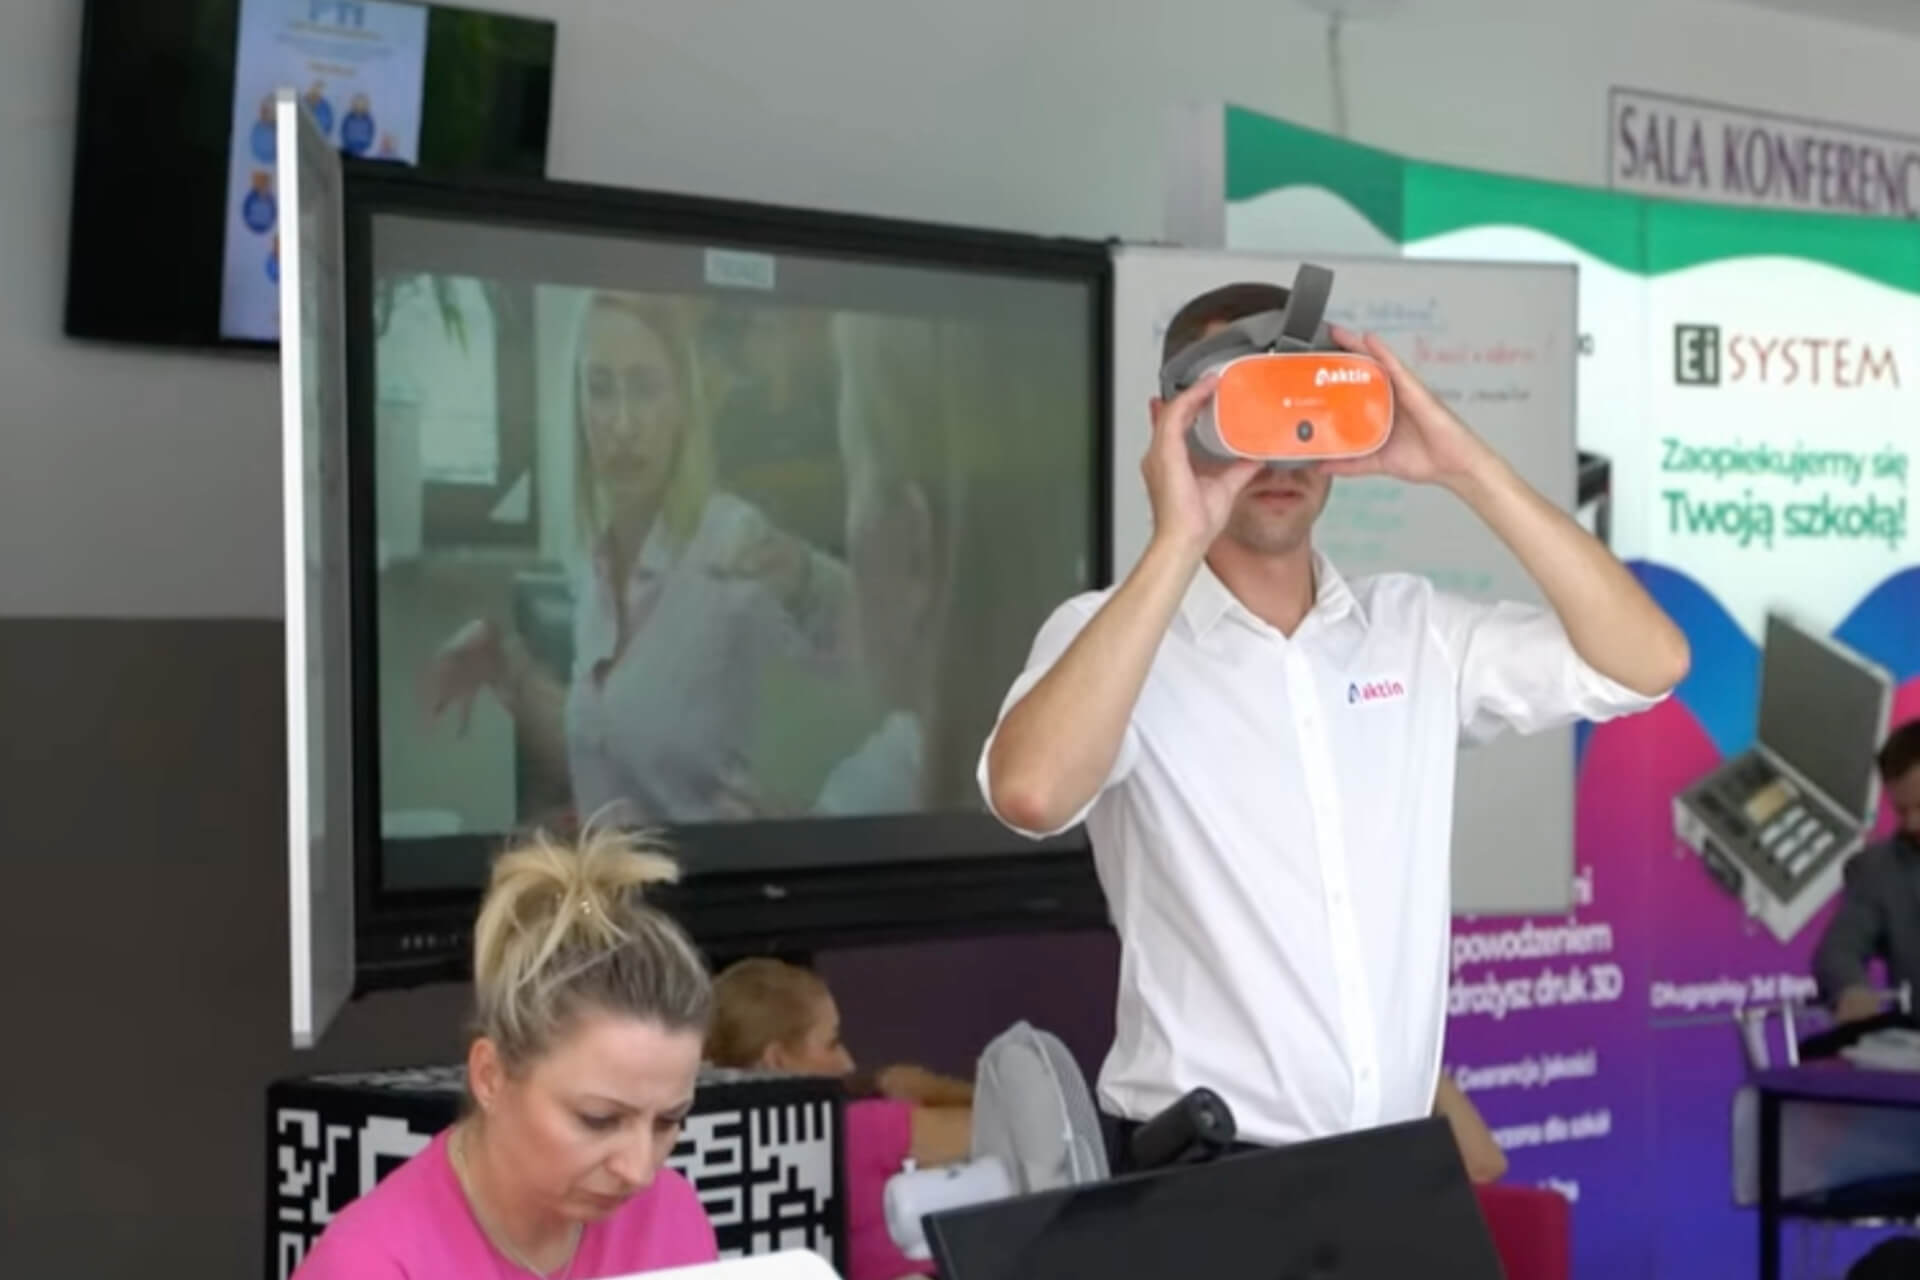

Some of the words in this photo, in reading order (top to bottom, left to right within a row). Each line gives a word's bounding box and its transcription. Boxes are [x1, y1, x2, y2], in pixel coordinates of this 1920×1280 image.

[1619, 103, 1709, 190] SALA
[1728, 335, 1901, 389] SYSTEM
[1661, 436, 1865, 487] Zaopiekujemy
[1872, 444, 1909, 490] się
[1661, 487, 1773, 551] Twoją
[1784, 492, 1907, 551] szkołą!
[1453, 917, 1614, 974] powodzeniem
[1535, 965, 1588, 1006] druk
[1589, 962, 1624, 1002] 3D
